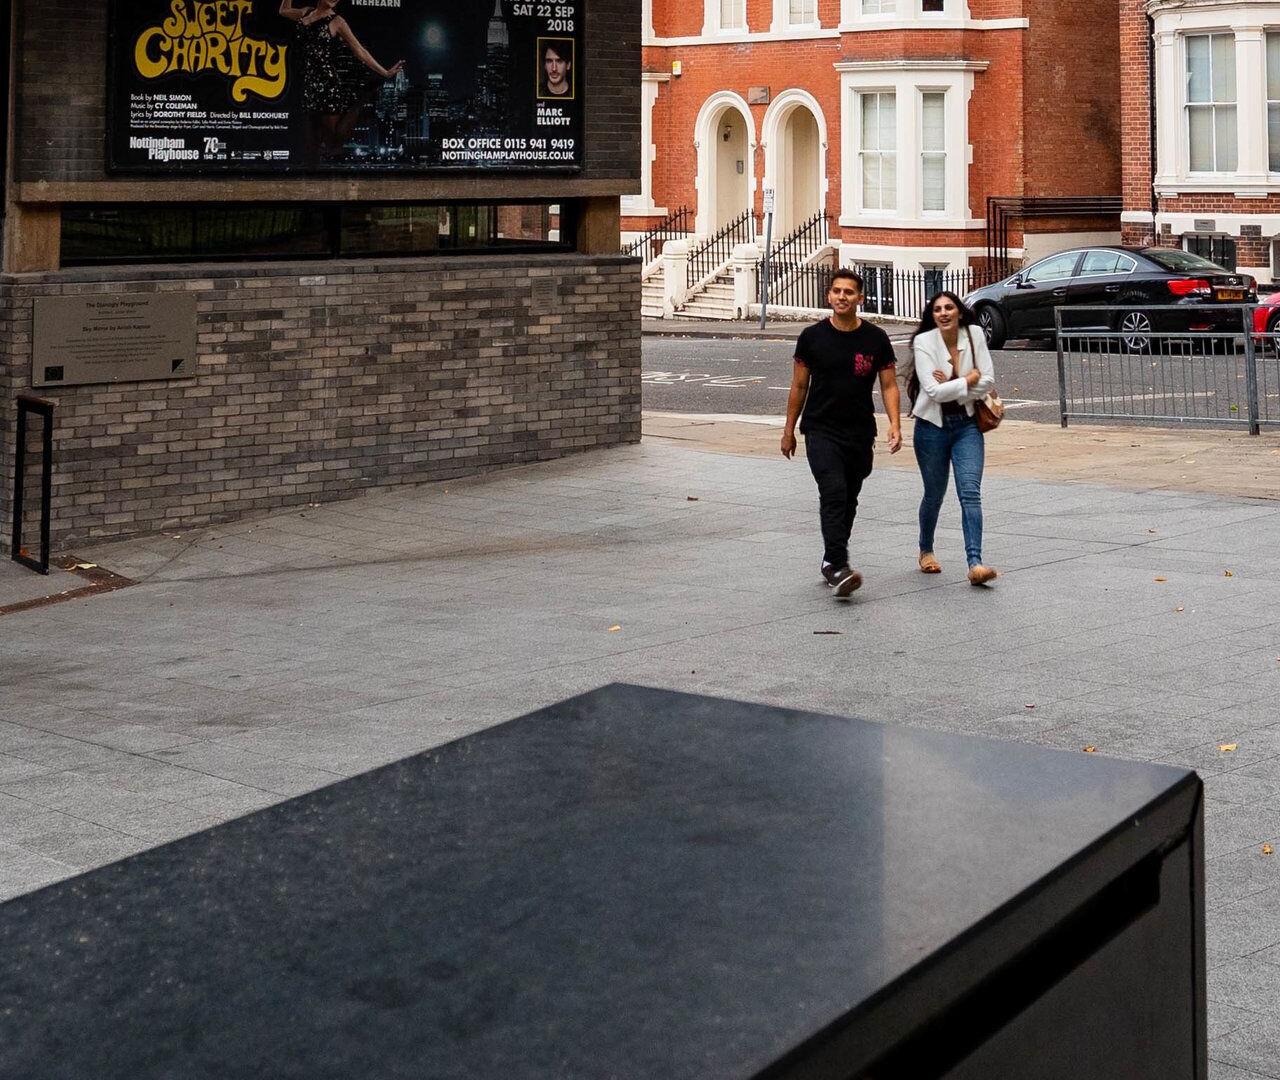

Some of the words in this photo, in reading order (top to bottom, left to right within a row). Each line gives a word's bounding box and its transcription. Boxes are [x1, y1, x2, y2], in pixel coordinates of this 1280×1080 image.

[513, 4, 533, 16] SAT
[537, 5, 551, 17] 22
[555, 6, 575, 18] SEP
[547, 19, 574, 32] 2018
[134, 26, 288, 102] CHARITY
[130, 93, 144, 101] Book
[144, 93, 152, 102] by
[147, 102, 154, 110] by
[145, 111, 153, 119] by
[210, 111, 230, 119] Directed
[231, 112, 238, 120] by
[536, 108, 563, 117] MARC
[536, 117, 571, 126] ELLIOTT
[129, 136, 185, 149] Nottingham
[442, 138, 465, 149] BOX
[468, 138, 501, 149] OFFICE
[504, 138, 526, 149] 0115
[529, 139, 546, 150] 941
[551, 139, 574, 150] 9419
[148, 148, 200, 162] Playhouse
[442, 151, 574, 161] NOTTINGHAMPLAYHOUSE.CO.UK
